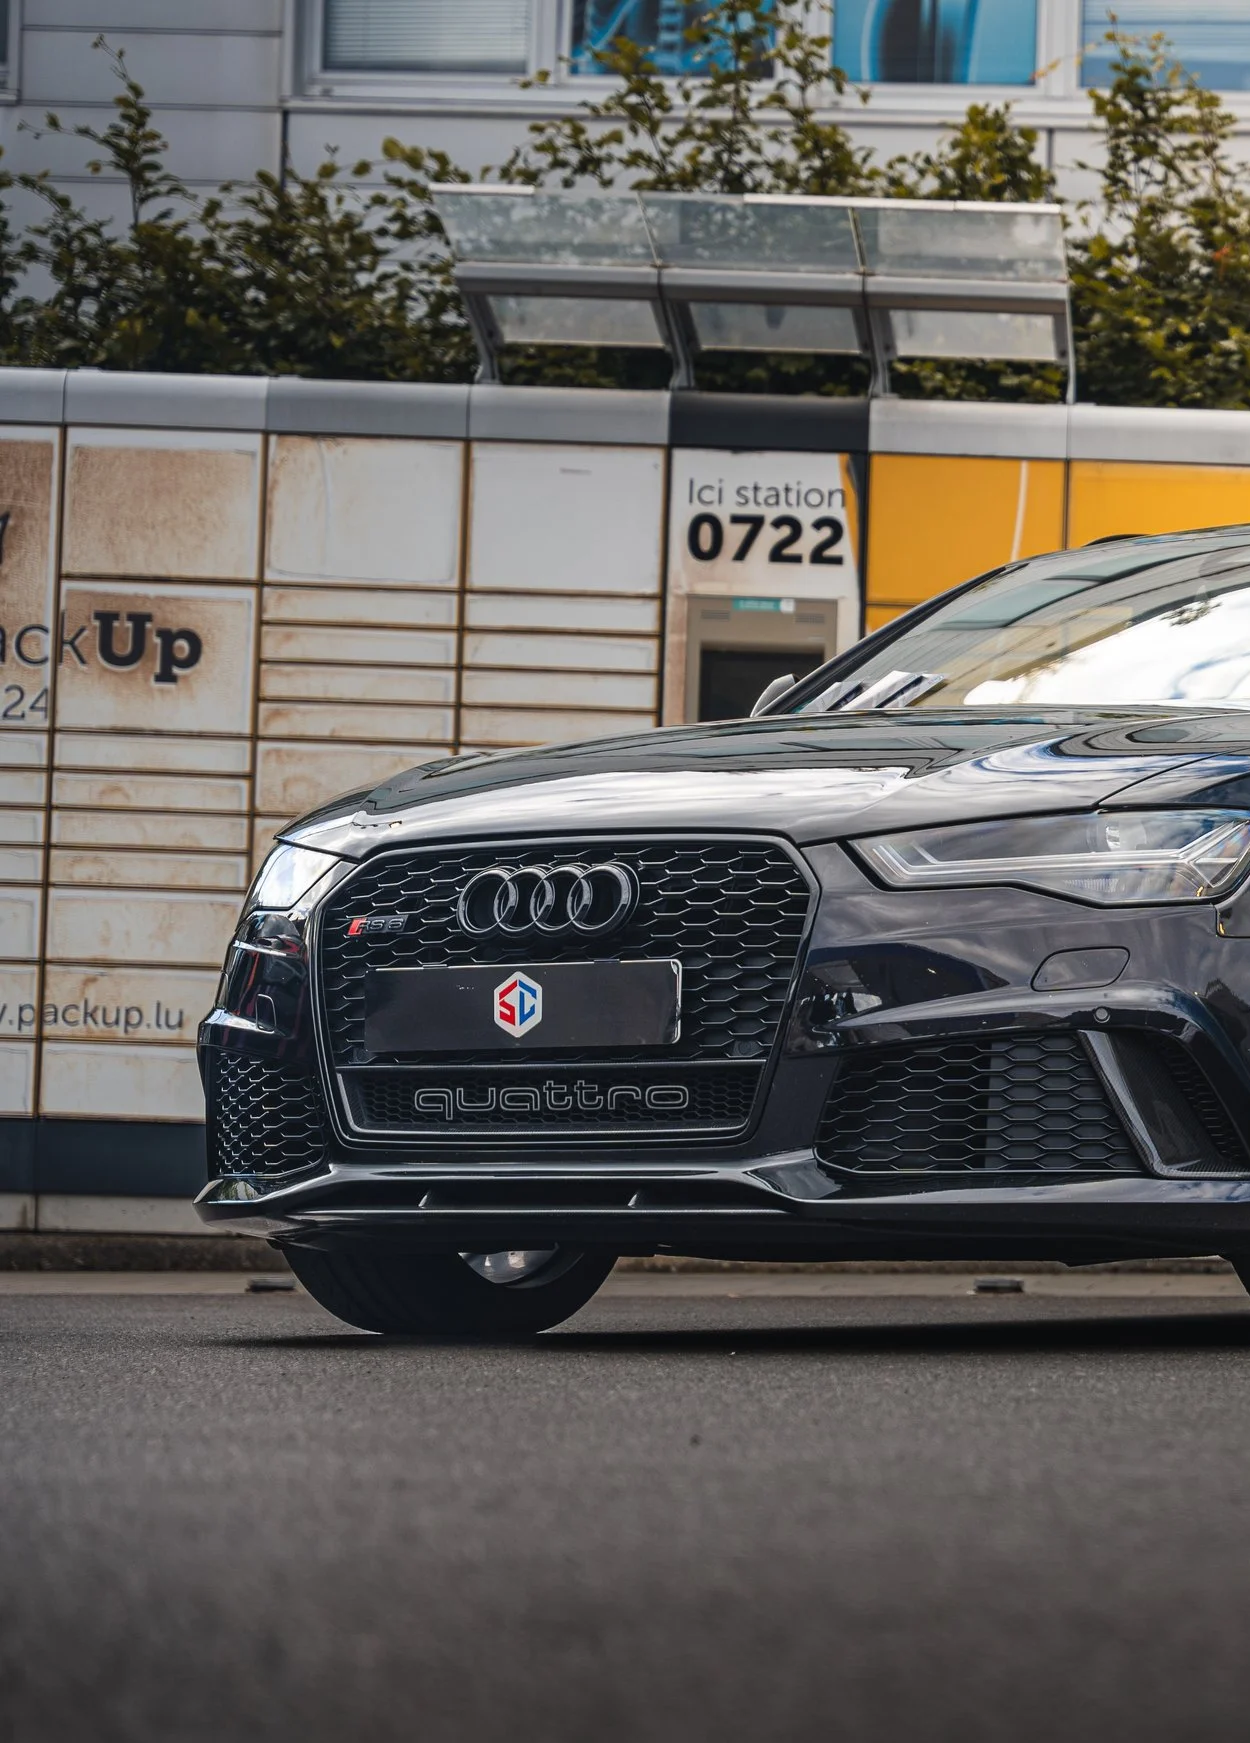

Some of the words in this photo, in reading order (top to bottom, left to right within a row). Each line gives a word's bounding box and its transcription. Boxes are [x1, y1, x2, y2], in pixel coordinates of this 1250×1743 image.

[688, 477, 724, 507] Ici
[735, 482, 846, 509] station
[687, 512, 844, 565] 0722
[0, 609, 203, 684] ckUp
[414, 1080, 689, 1120] quattro
